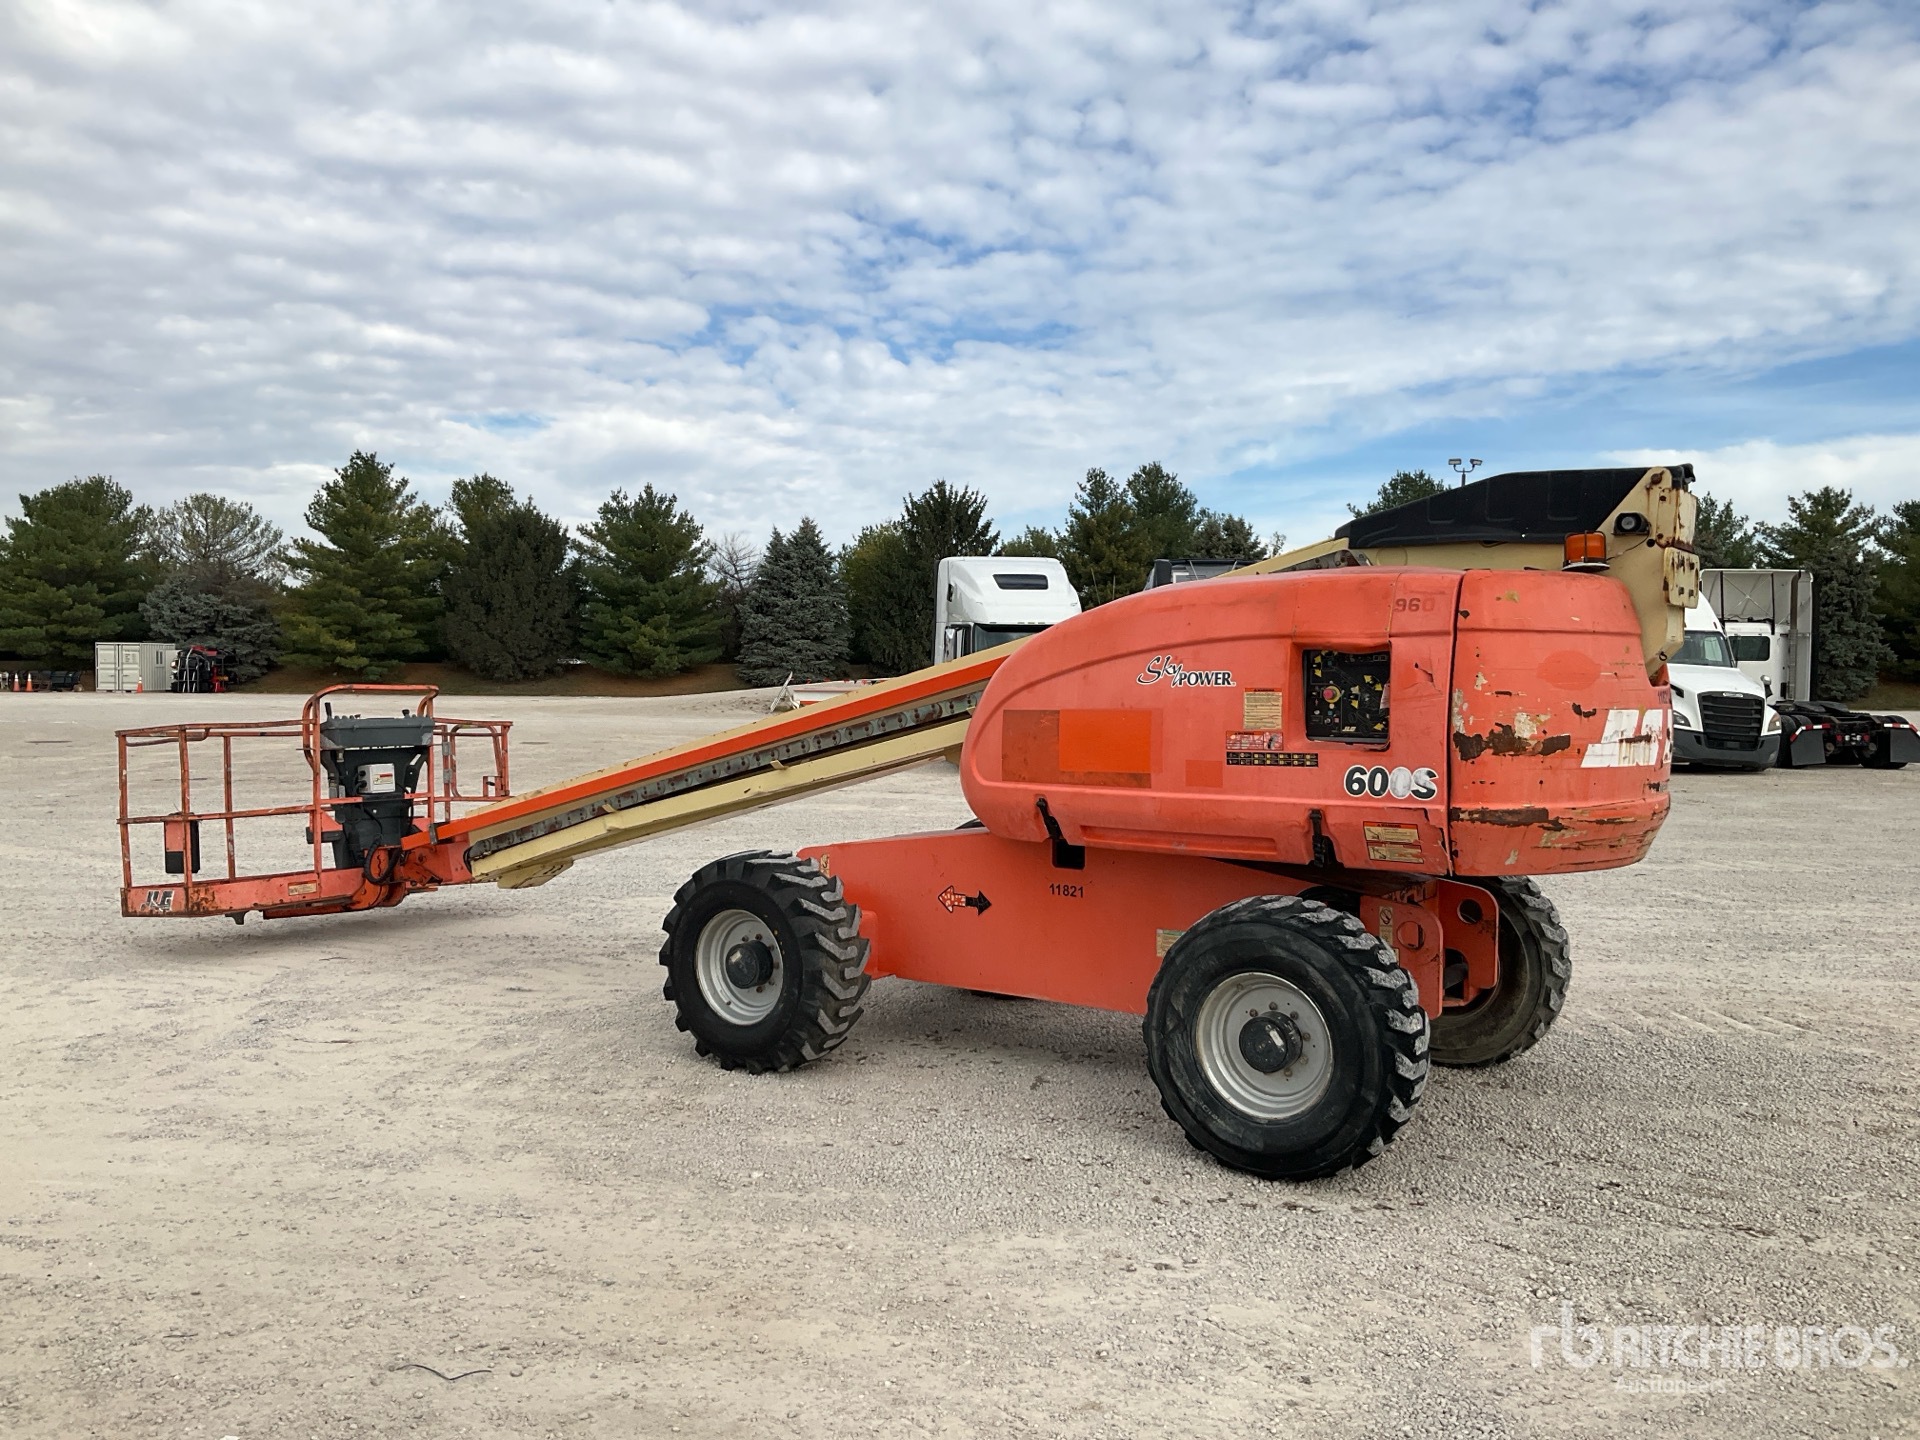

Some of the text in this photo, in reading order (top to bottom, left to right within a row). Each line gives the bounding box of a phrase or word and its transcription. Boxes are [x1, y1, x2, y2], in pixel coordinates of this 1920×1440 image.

[1137, 655, 1233, 687] Sky POWER
[1344, 765, 1439, 800] 600S
[1049, 883, 1084, 898] 11821
